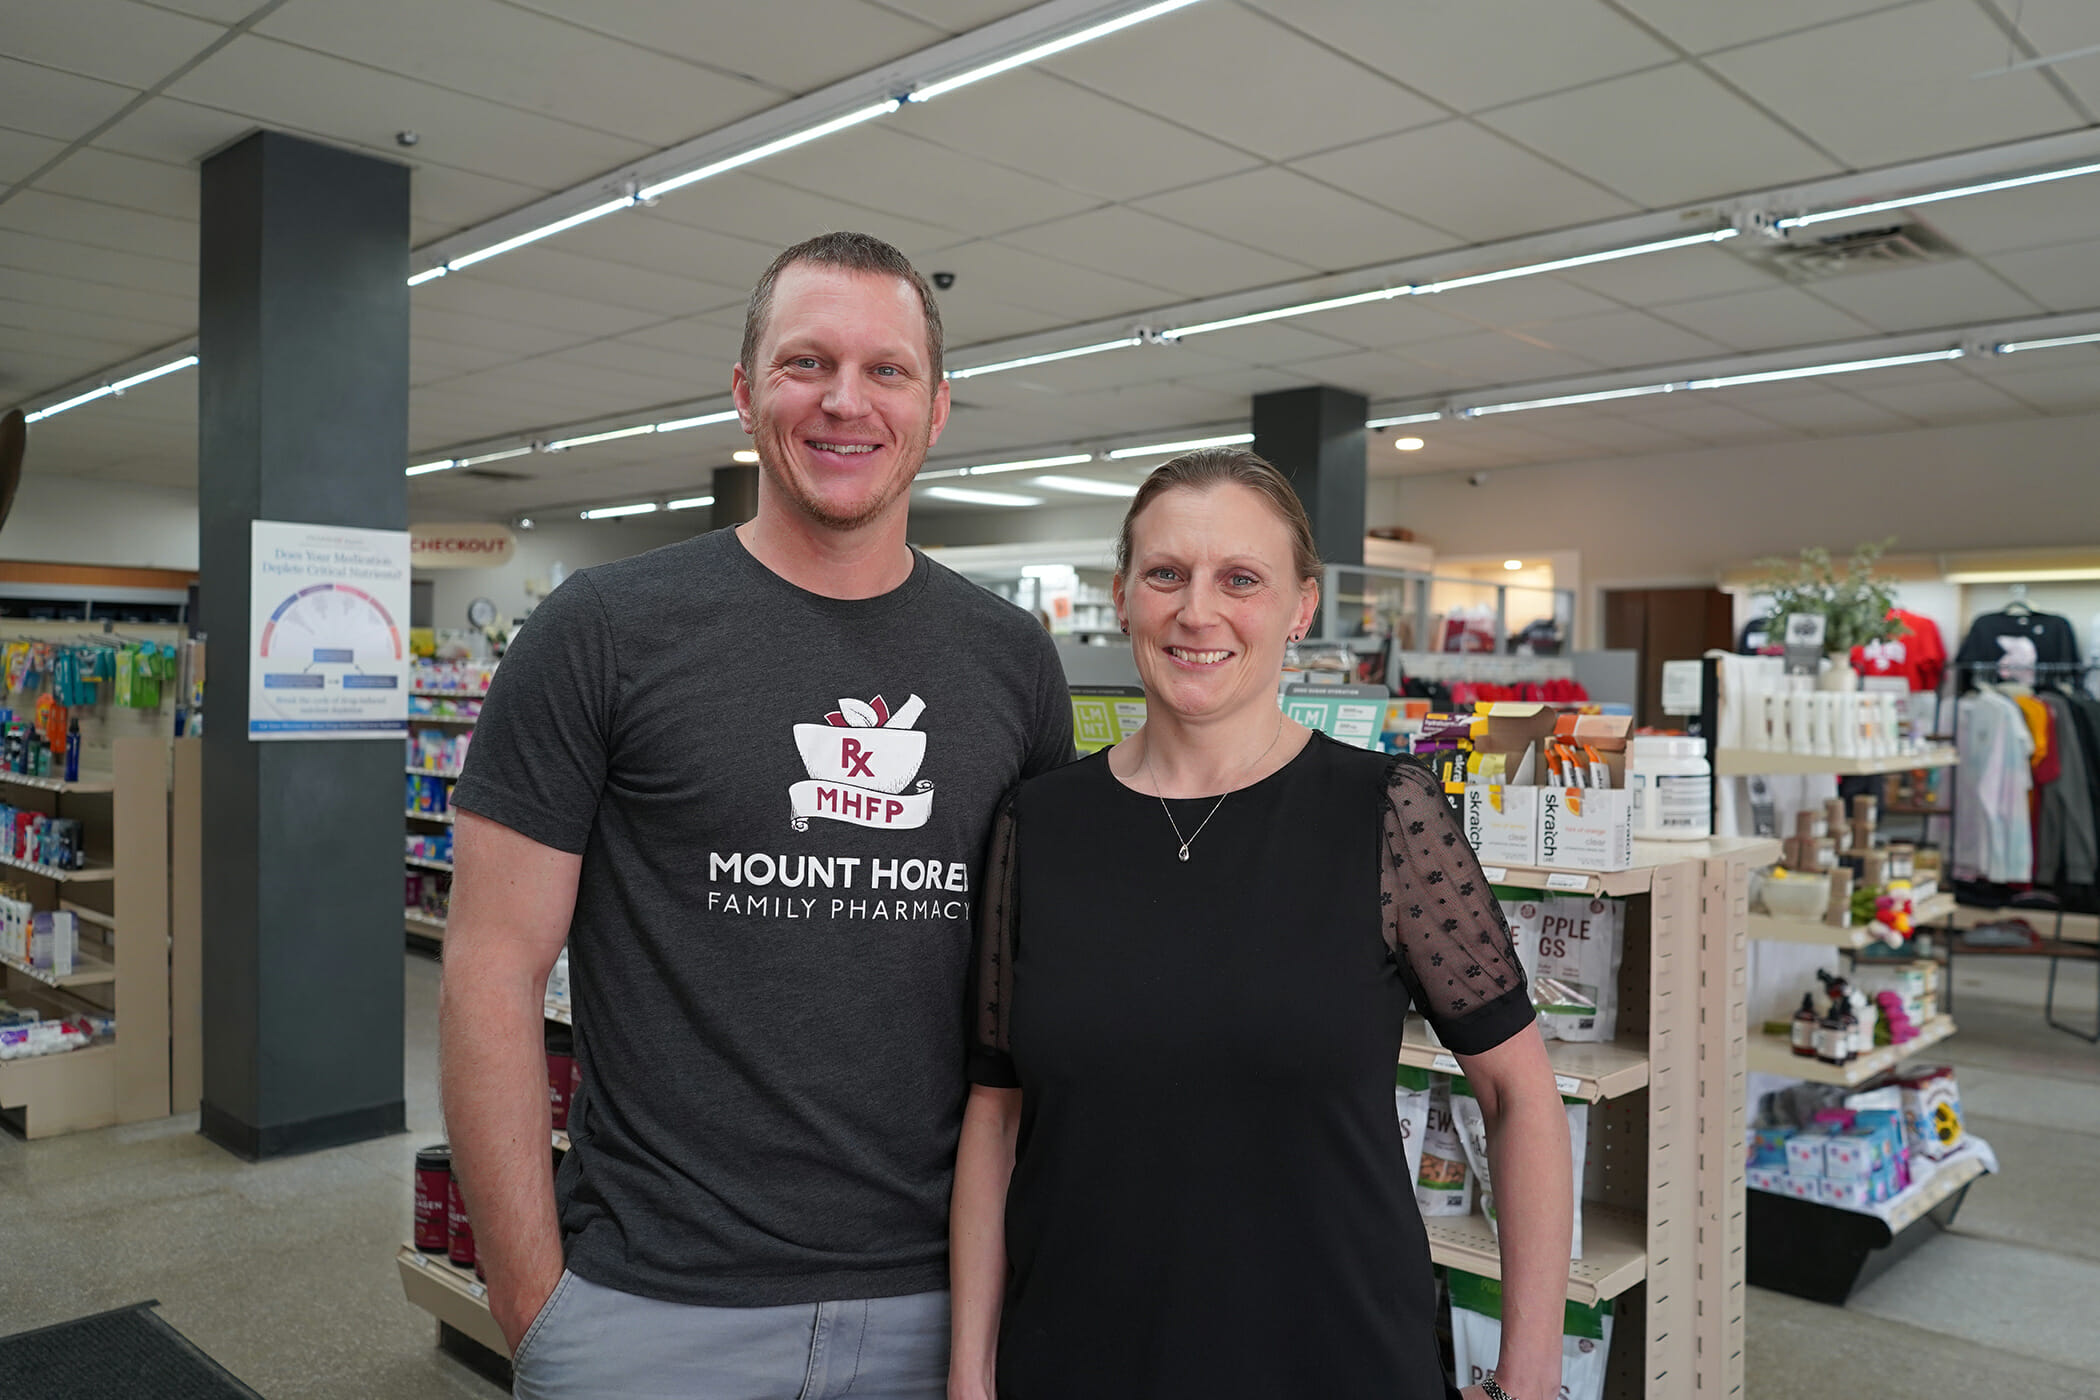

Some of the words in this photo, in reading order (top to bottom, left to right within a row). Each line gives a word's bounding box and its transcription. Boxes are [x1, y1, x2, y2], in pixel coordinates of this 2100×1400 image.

[411, 537, 506, 553] CHECKOUT
[1079, 707, 1102, 721] LM
[1083, 722, 1105, 737] NT
[1294, 709, 1320, 725] LM
[841, 737, 875, 777] Rx
[816, 786, 904, 823] MHFP
[1470, 791, 1482, 852] skratch
[1544, 794, 1559, 856] skratch
[709, 852, 860, 889] MOUNT
[708, 892, 817, 919] FAMILY
[832, 899, 970, 921] PHARMACY
